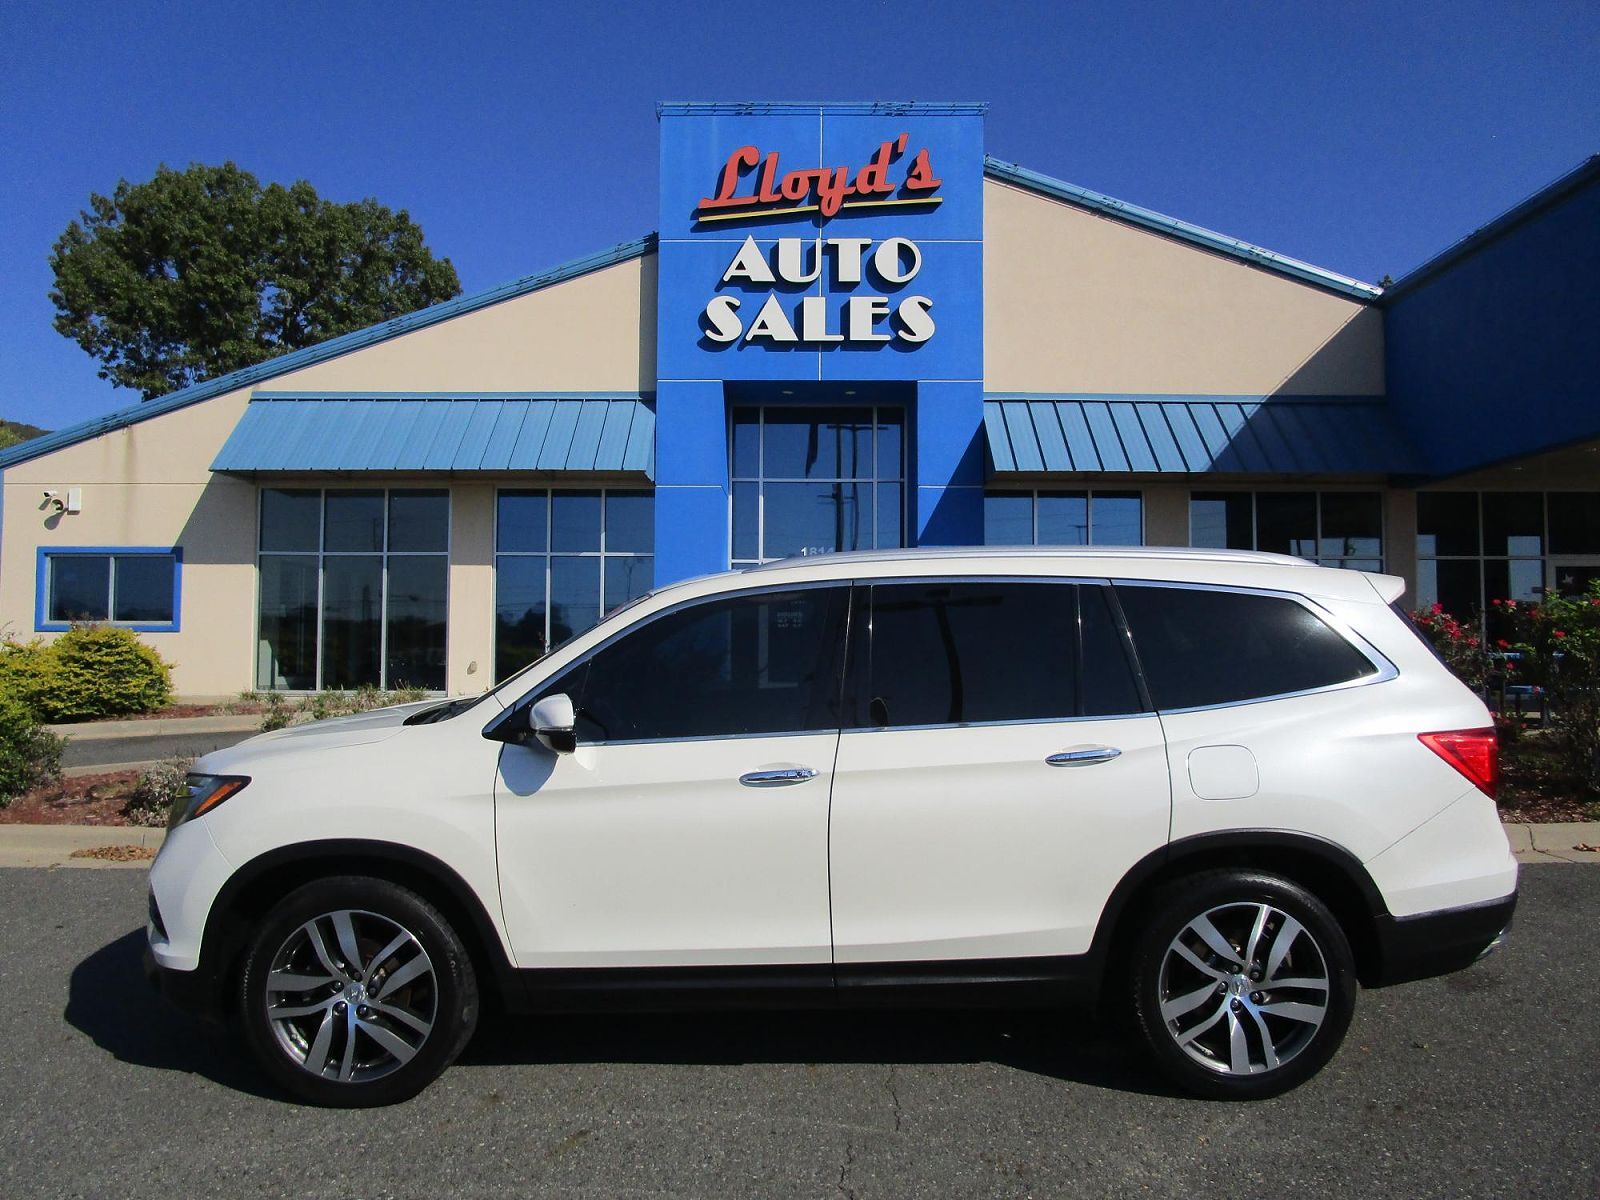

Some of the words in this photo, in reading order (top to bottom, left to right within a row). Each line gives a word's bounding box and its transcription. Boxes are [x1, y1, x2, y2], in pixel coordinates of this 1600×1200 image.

[697, 132, 942, 216] Lloyd's
[723, 235, 921, 283] AUTO
[704, 293, 935, 342] SALES
